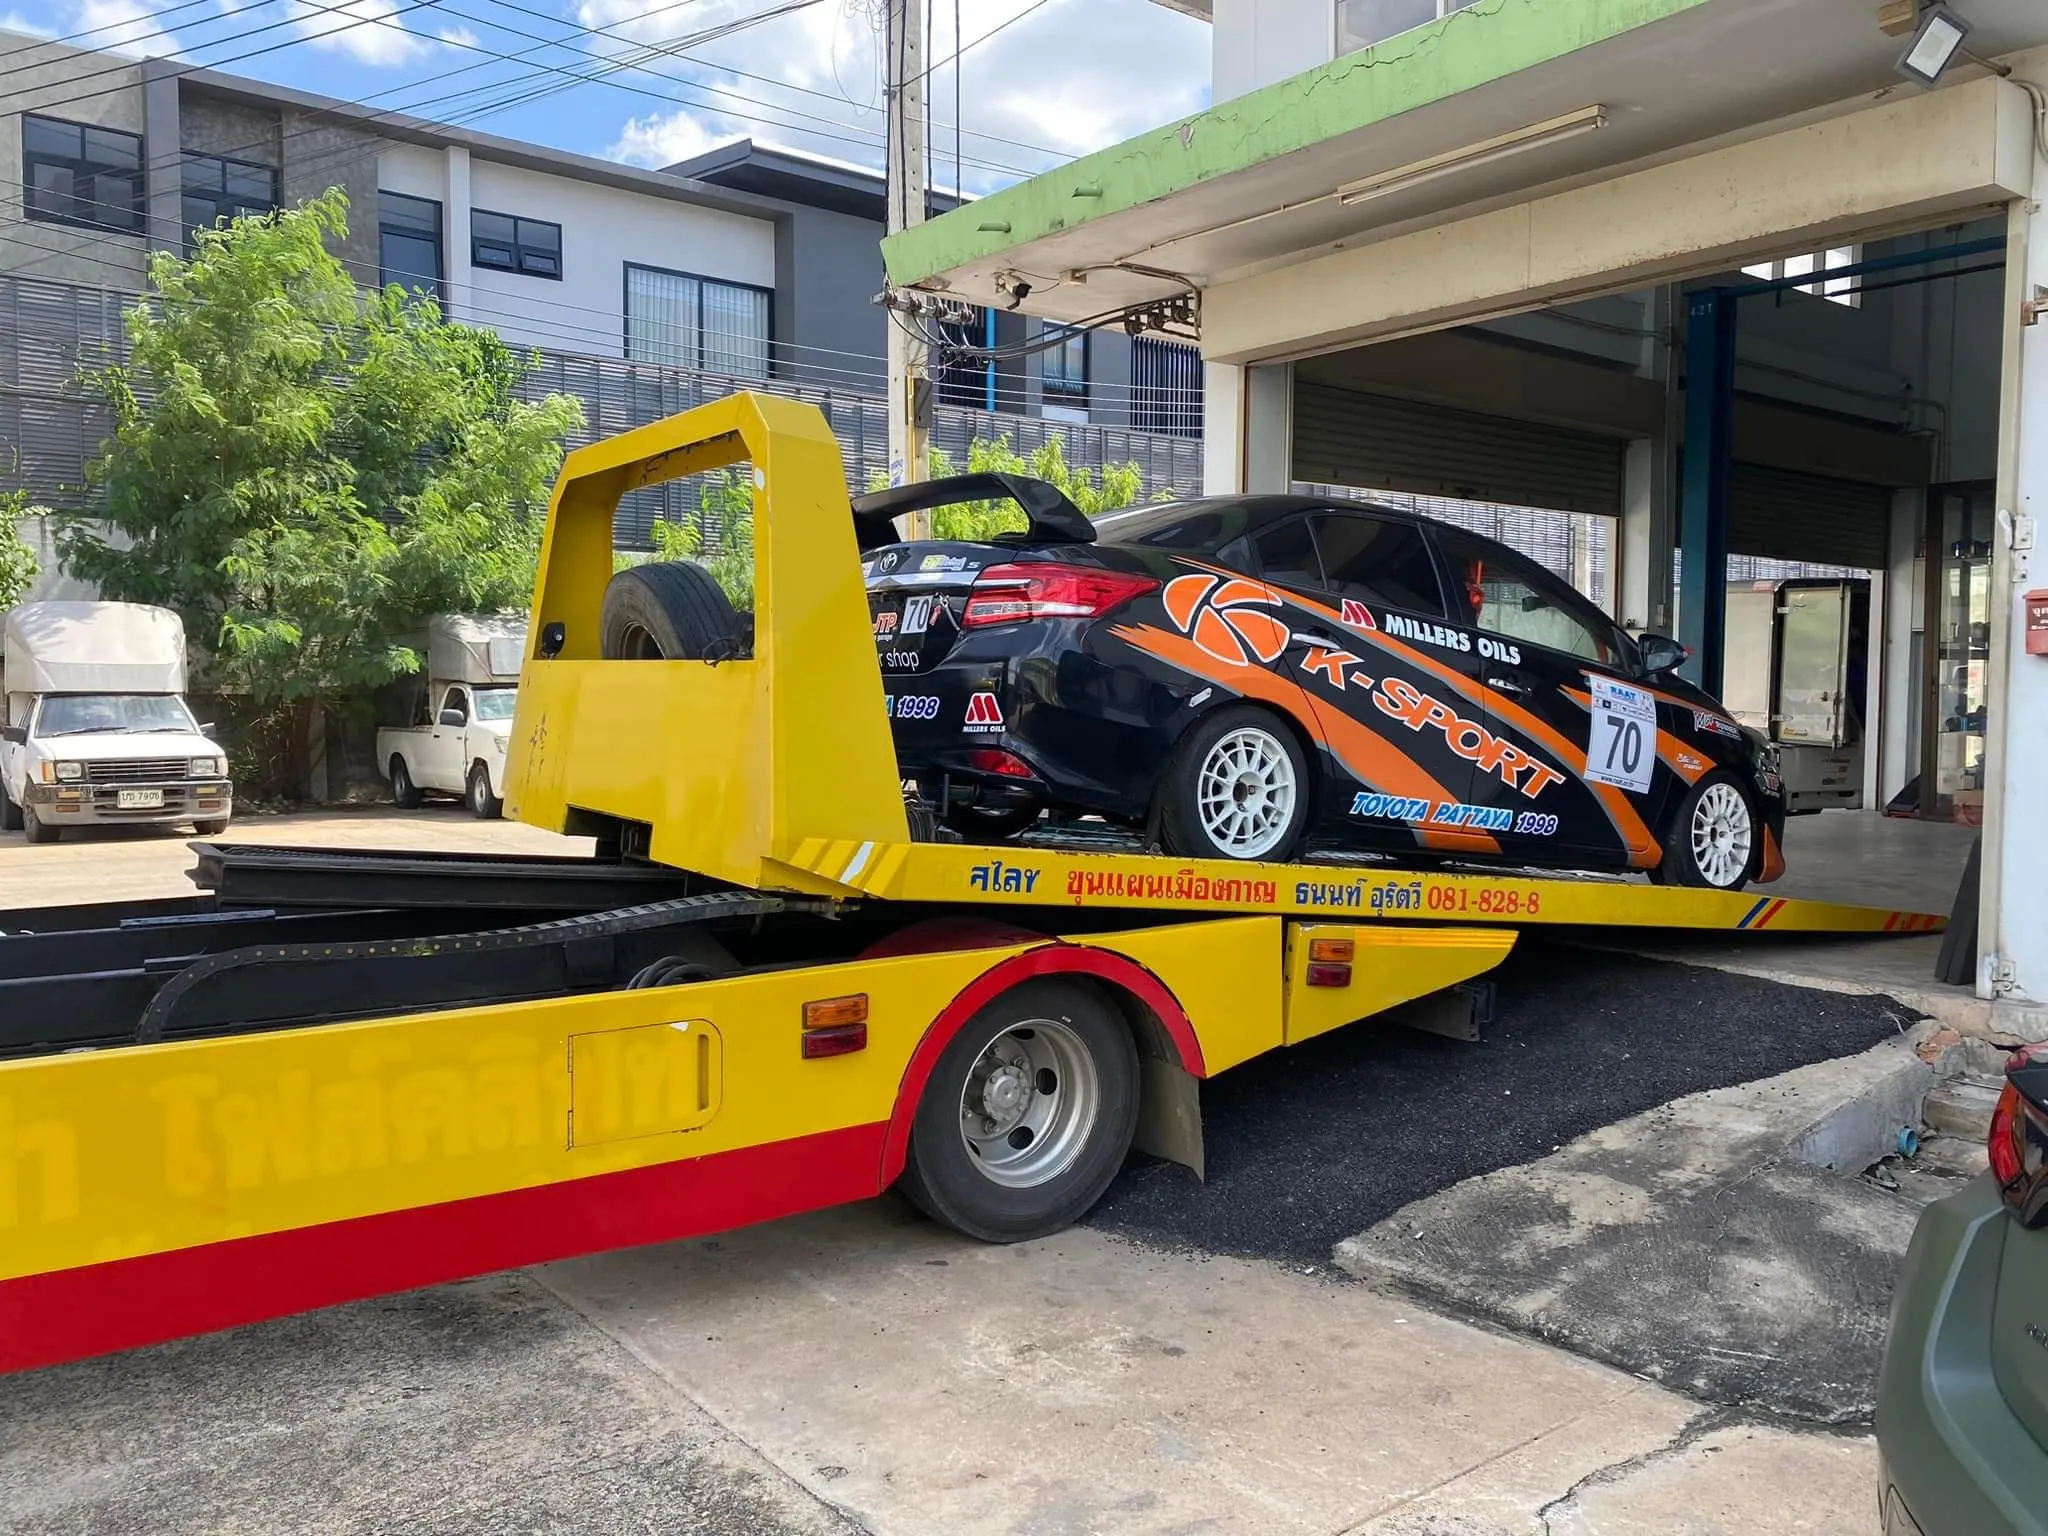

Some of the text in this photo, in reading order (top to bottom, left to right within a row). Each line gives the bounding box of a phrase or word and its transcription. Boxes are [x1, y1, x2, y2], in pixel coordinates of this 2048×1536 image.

[907, 599, 929, 631] 70
[1385, 614, 1521, 665] MILLERS OILS
[886, 648, 920, 671] shop
[897, 695, 940, 719] 1998
[1300, 646, 1567, 799] K-SPORT
[989, 725, 1006, 733] OILS
[1606, 714, 1642, 774] 70
[1349, 792, 1558, 835] TOYOTA PATTAYA 1998
[1427, 885, 1540, 915] 081-828-8
